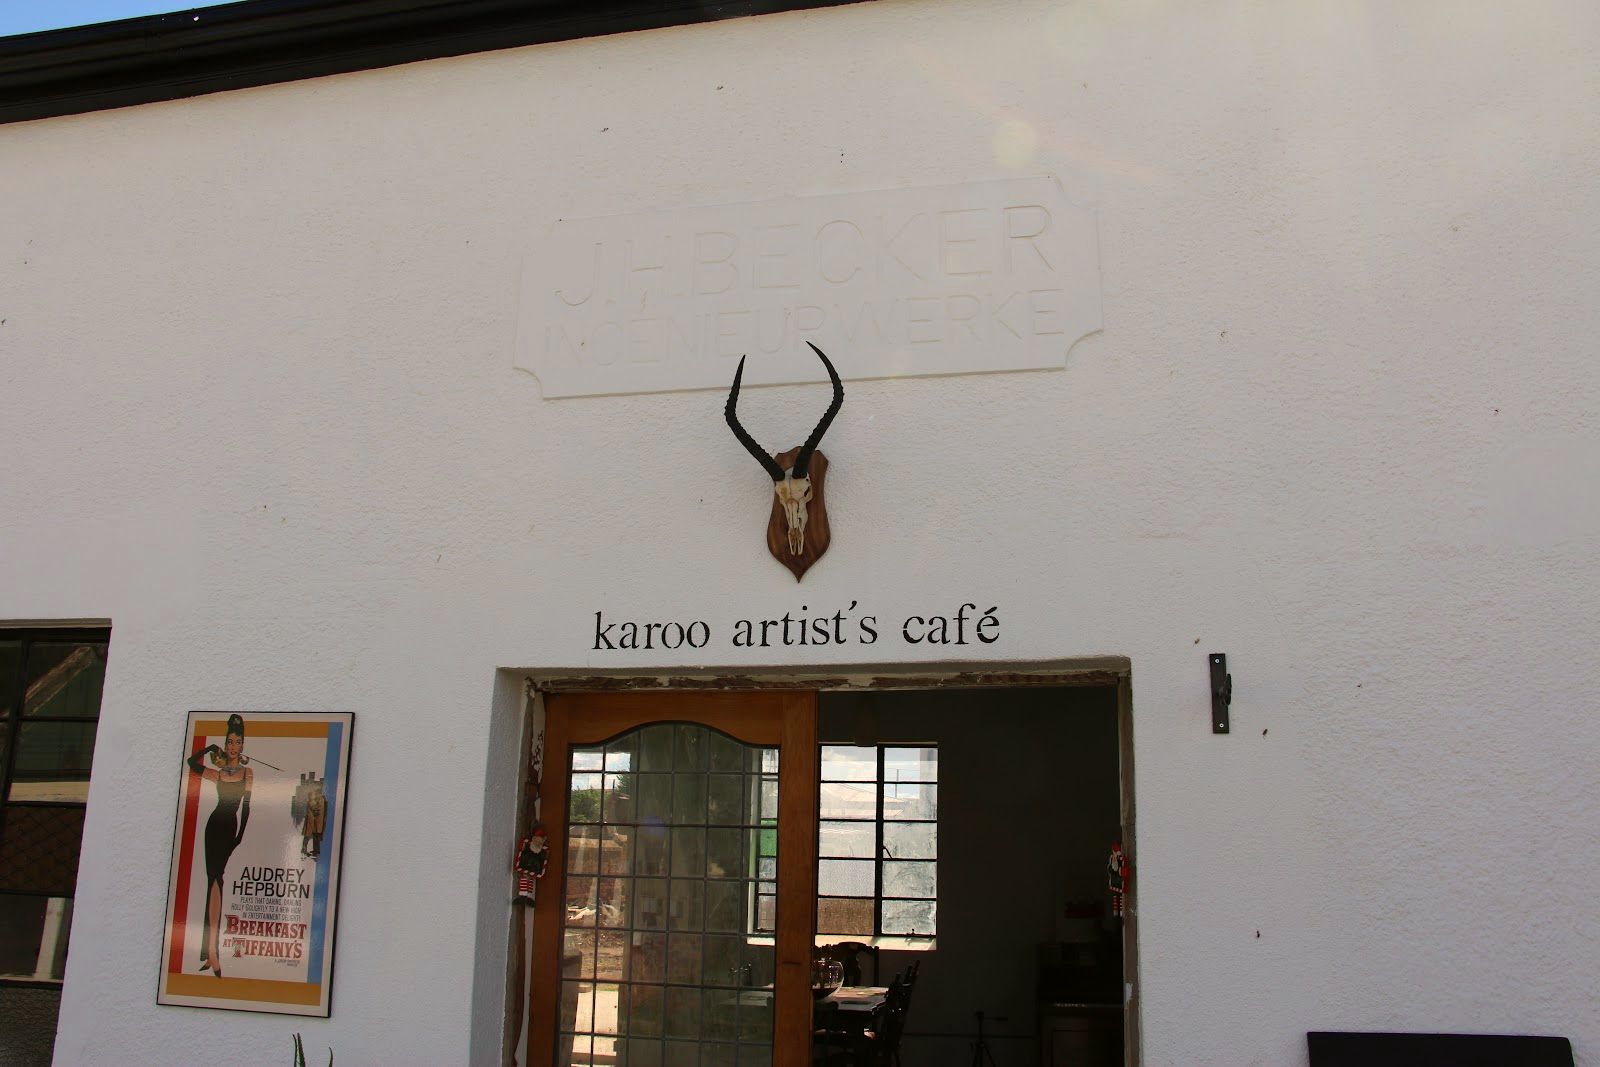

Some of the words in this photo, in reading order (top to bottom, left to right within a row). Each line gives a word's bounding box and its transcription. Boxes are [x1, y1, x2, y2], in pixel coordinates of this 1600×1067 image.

[591, 611, 711, 650] karoo
[732, 600, 878, 647] artist's
[902, 602, 1001, 645] café
[240, 866, 305, 883] AUDREY
[232, 880, 311, 899] HEPBURN
[223, 913, 307, 939] BREAKFAST
[222, 938, 232, 948] AT
[232, 937, 303, 959] TIFFANY'S
